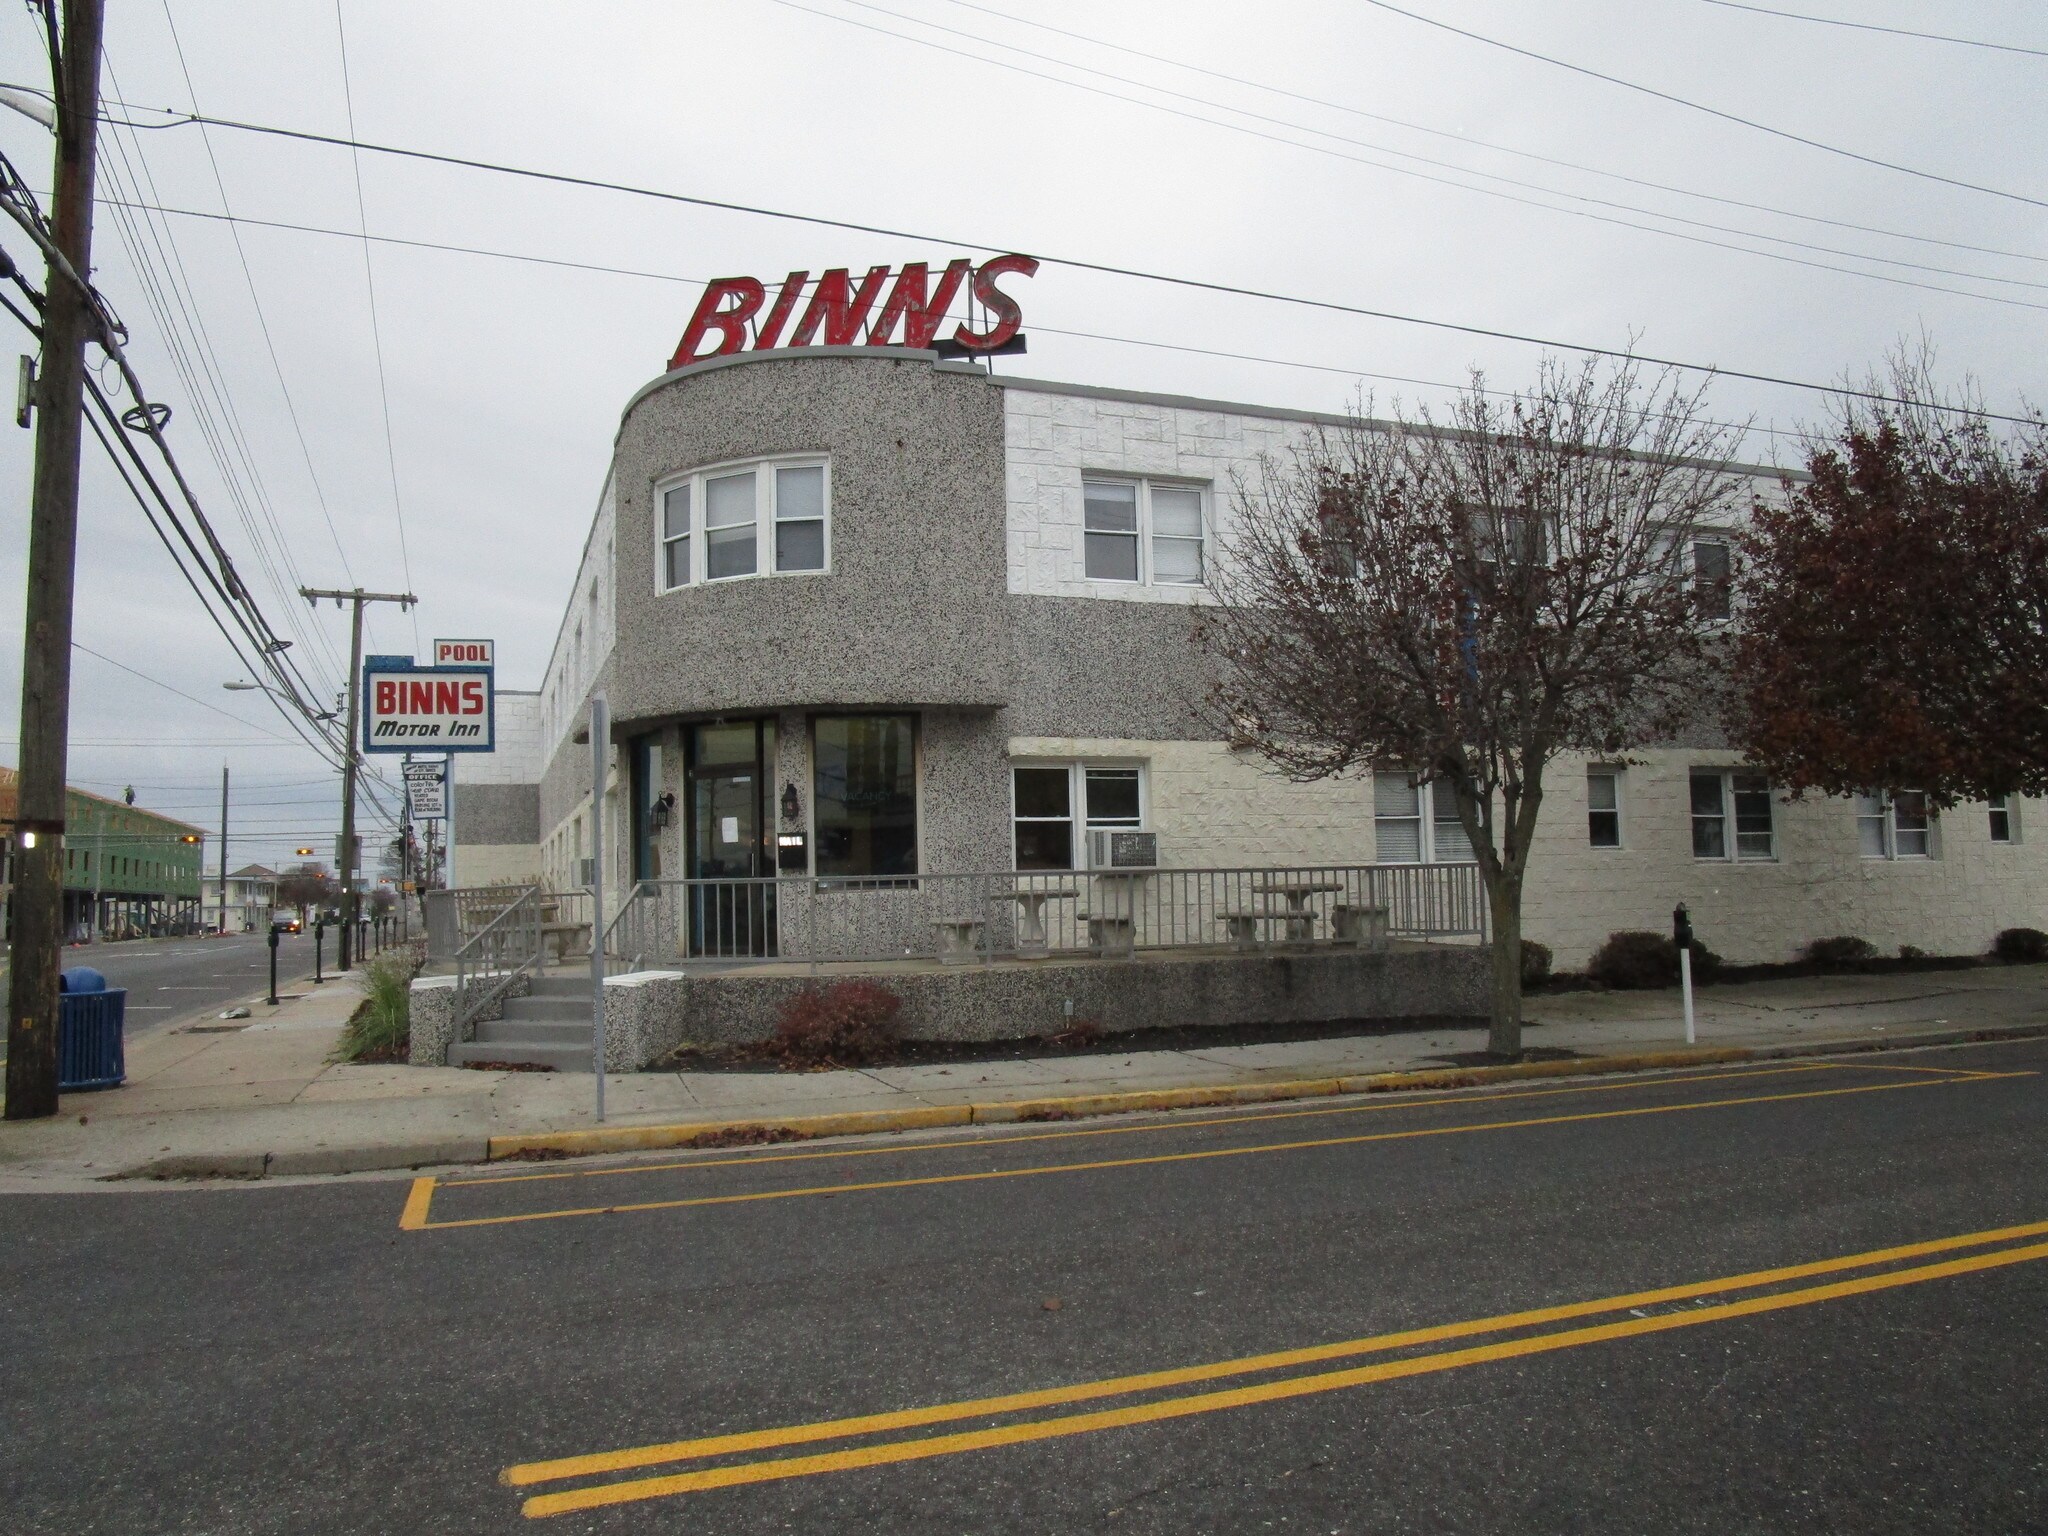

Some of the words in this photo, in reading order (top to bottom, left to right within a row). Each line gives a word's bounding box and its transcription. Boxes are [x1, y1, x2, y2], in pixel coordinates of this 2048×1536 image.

[666, 254, 1040, 371] BINNS
[439, 645, 490, 661] POOL
[376, 681, 484, 715] BINNS
[448, 720, 481, 737] Inn
[840, 791, 892, 801] VACANCY
